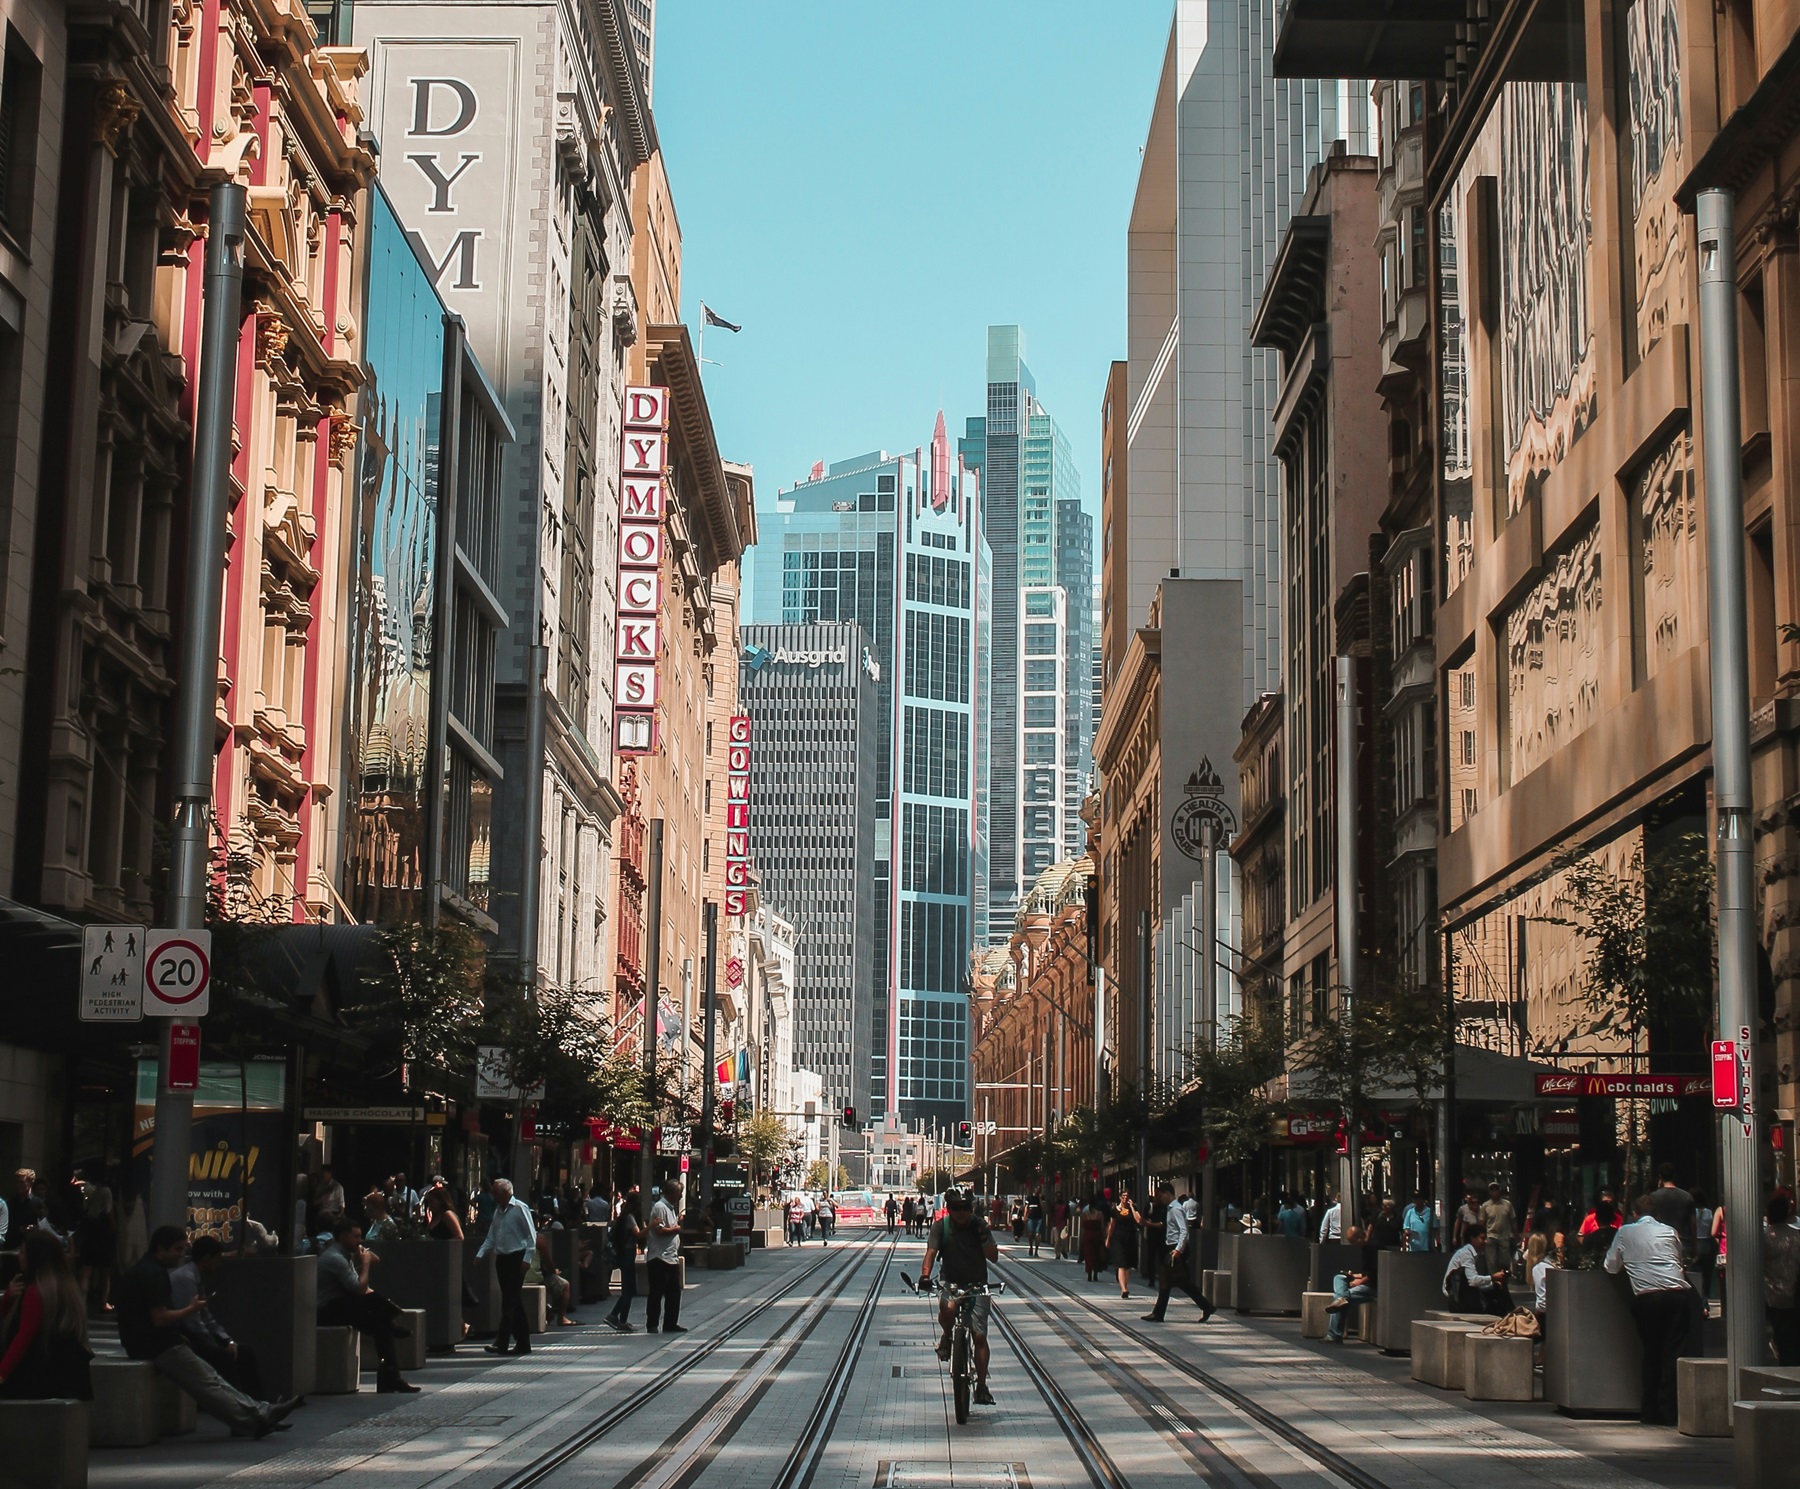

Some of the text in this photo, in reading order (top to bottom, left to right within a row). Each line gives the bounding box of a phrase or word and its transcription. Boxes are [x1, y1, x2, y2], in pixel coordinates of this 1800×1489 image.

[405, 76, 484, 292] DYM
[623, 393, 659, 703] DYMOCKS
[773, 645, 846, 668] Ausgrid
[1182, 799, 1225, 815] HEALTH
[727, 719, 749, 915] GOWINGS
[1174, 828, 1196, 855] CARE
[159, 958, 195, 986] 20
[181, 1028, 190, 1036] NO
[1719, 1044, 1727, 1052] NO
[1714, 1053, 1732, 1061] STOPPING
[1541, 1077, 1577, 1093] McCafé
[1685, 1079, 1712, 1094] McCa
[309, 1109, 349, 1117] HAIGH'S
[139, 1116, 155, 1131] NE
[203, 1190, 223, 1198] with
[186, 1197, 244, 1224] ramel
[729, 1201, 750, 1211] UGG
[186, 1221, 234, 1243] wist
